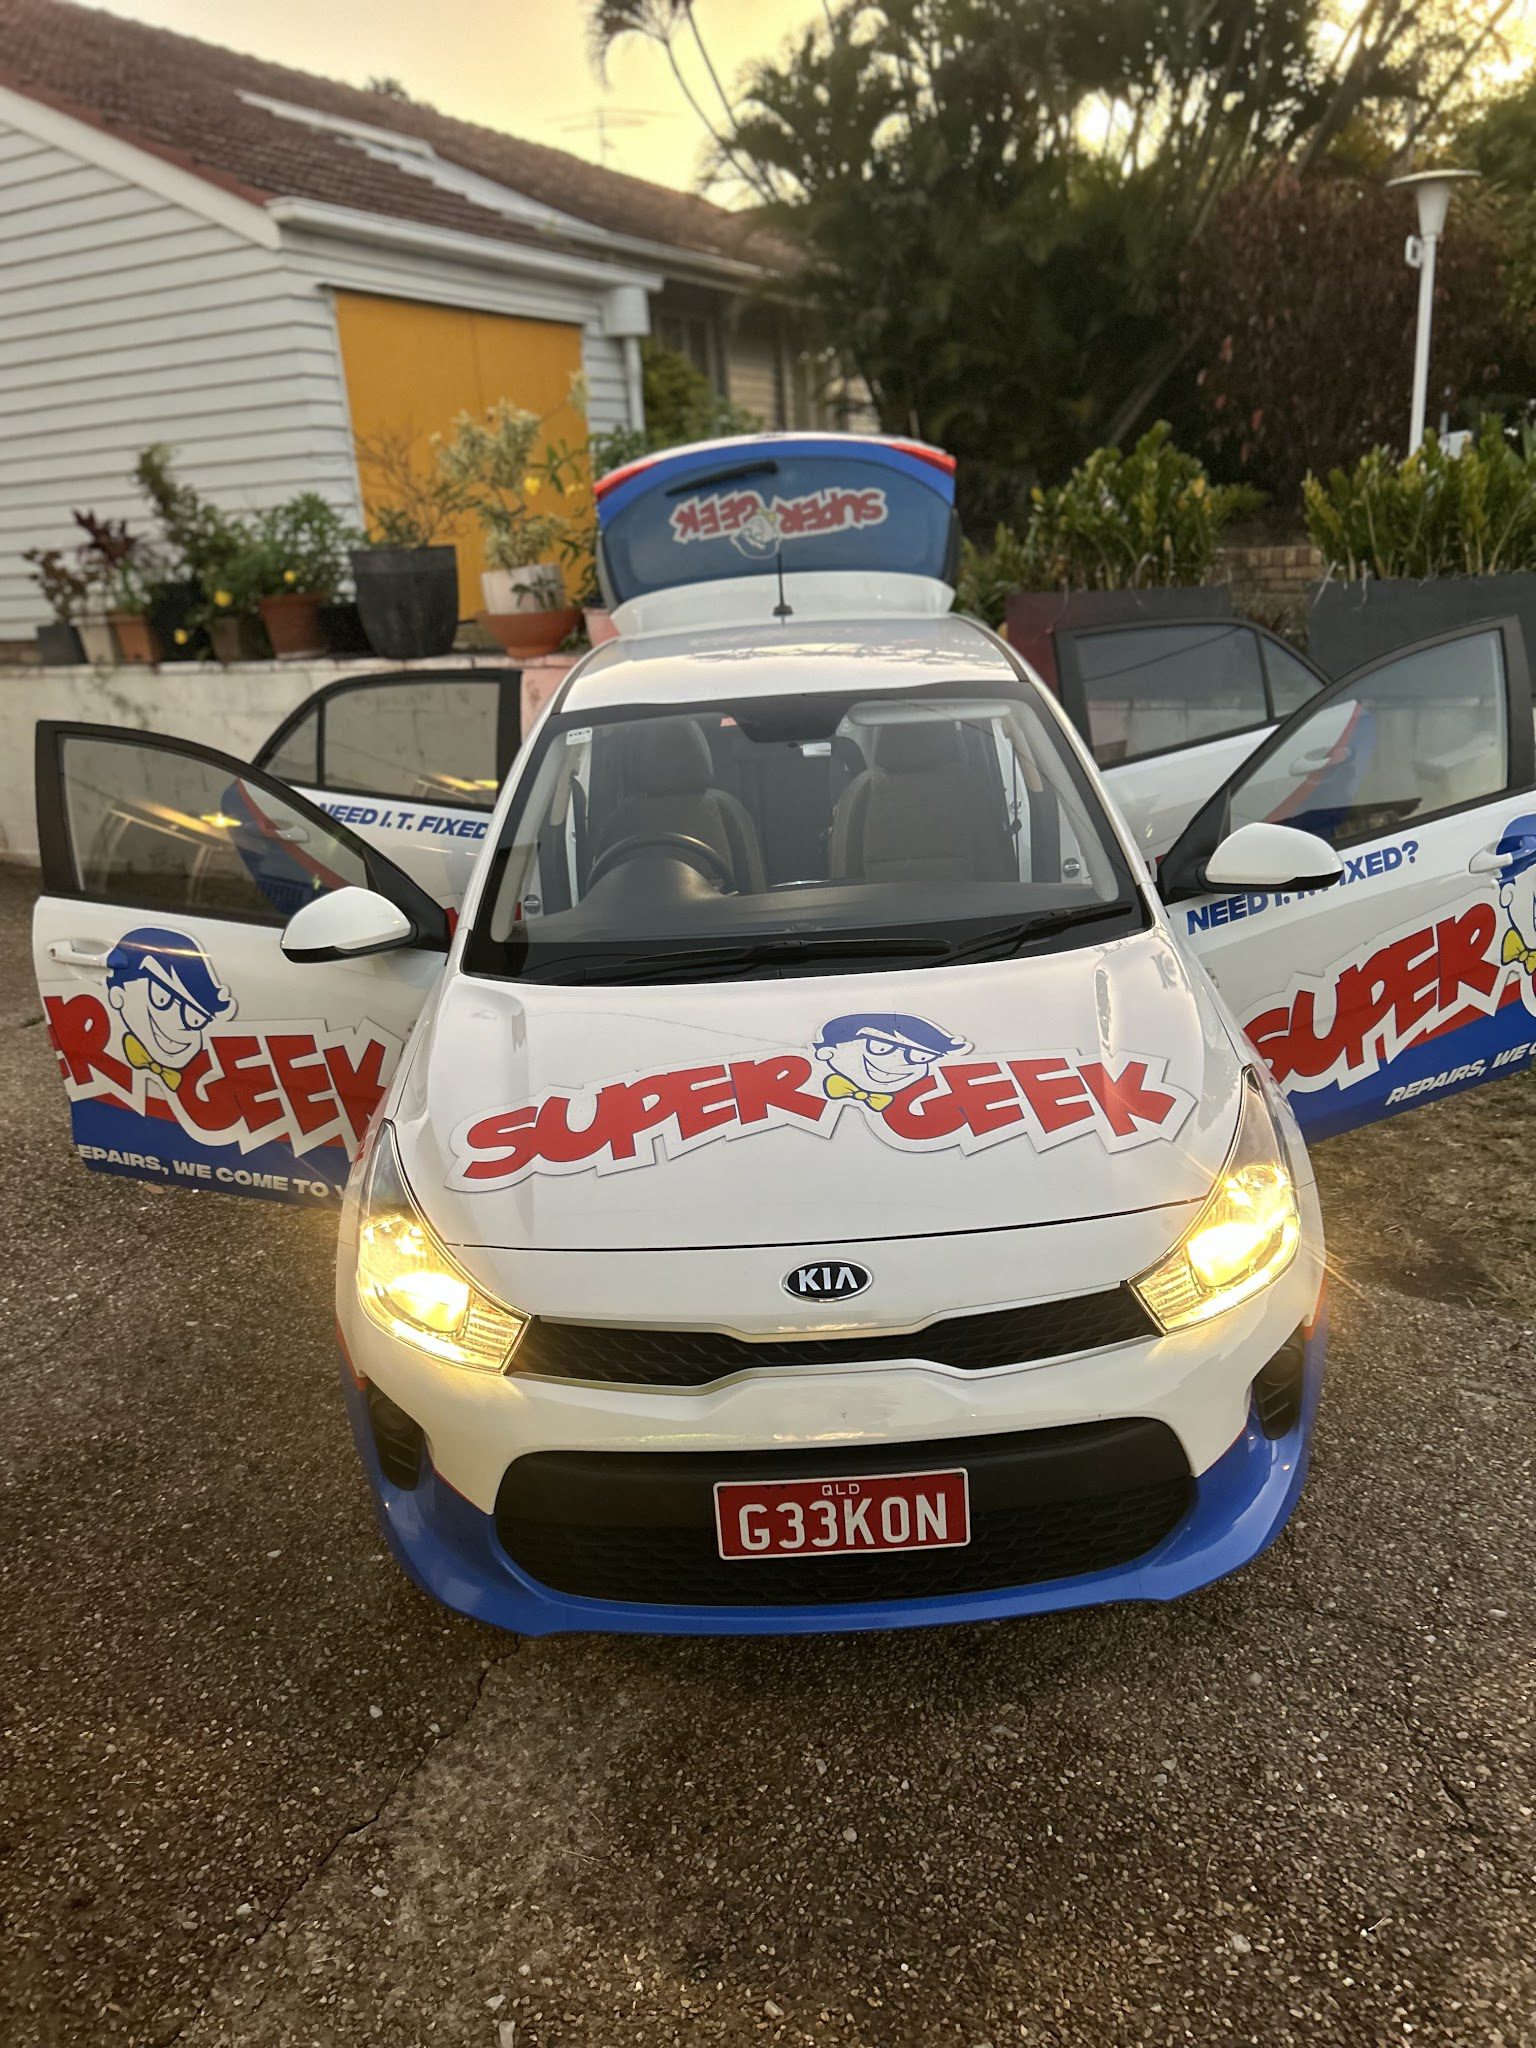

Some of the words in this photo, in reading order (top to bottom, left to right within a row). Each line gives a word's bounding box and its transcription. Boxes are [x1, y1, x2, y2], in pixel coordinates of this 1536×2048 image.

[674, 494, 760, 539] GEEK
[775, 491, 884, 535] SUPER
[1186, 892, 1269, 936] NEED
[1322, 840, 1419, 892] IXED?
[1242, 902, 1500, 1085] SUPER
[175, 1033, 388, 1143] GEEK
[1384, 1059, 1487, 1106] REPAIRS,
[1491, 1042, 1532, 1069] WE
[463, 1055, 828, 1180] SUPER
[882, 1057, 1177, 1140] GEEK
[173, 1159, 212, 1180] WE
[215, 1167, 289, 1192] COME
[293, 1178, 330, 1198] TO
[797, 1266, 859, 1292] KIA
[821, 1483, 861, 1497] QLD
